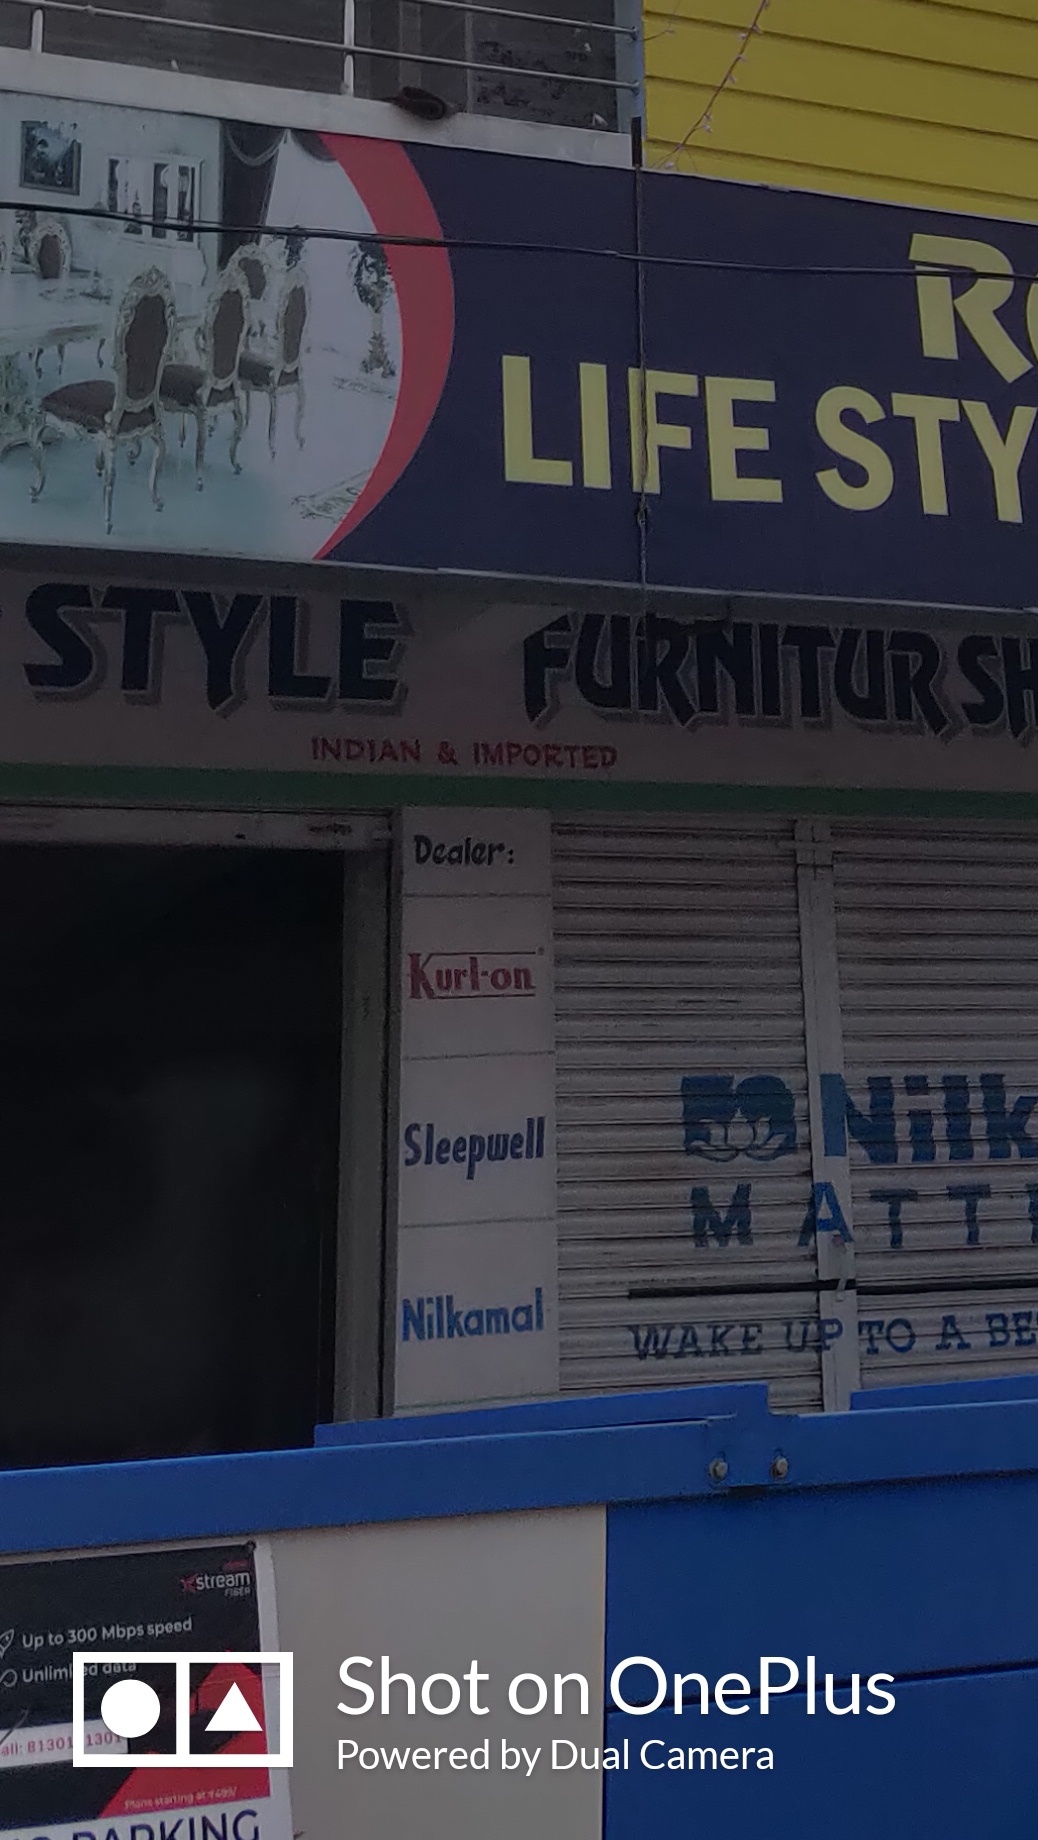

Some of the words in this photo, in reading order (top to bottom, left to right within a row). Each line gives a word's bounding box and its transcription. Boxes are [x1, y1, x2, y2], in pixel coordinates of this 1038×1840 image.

[502, 354, 784, 504] LIFE
[23, 582, 406, 715] STYLE
[523, 612, 952, 735] FURNITUR
[311, 735, 423, 765] INDIAN
[437, 740, 459, 766] &
[473, 740, 619, 771] IMPORTED
[413, 834, 515, 867] Dealer:
[408, 952, 536, 1000] Kurl-on
[404, 1116, 547, 1180] Sleepwell
[401, 1287, 545, 1343] Nilkamal
[627, 1322, 765, 1361] WAKE
[783, 1318, 844, 1355] UP
[858, 1318, 917, 1354] TO
[935, 1315, 971, 1351] A
[22, 1633, 45, 1651] Up
[48, 1632, 64, 1646] to
[67, 1627, 98, 1644] 300
[102, 1623, 144, 1641] Mbps
[146, 1616, 194, 1637] speed
[22, 1663, 99, 1683] Unlimied
